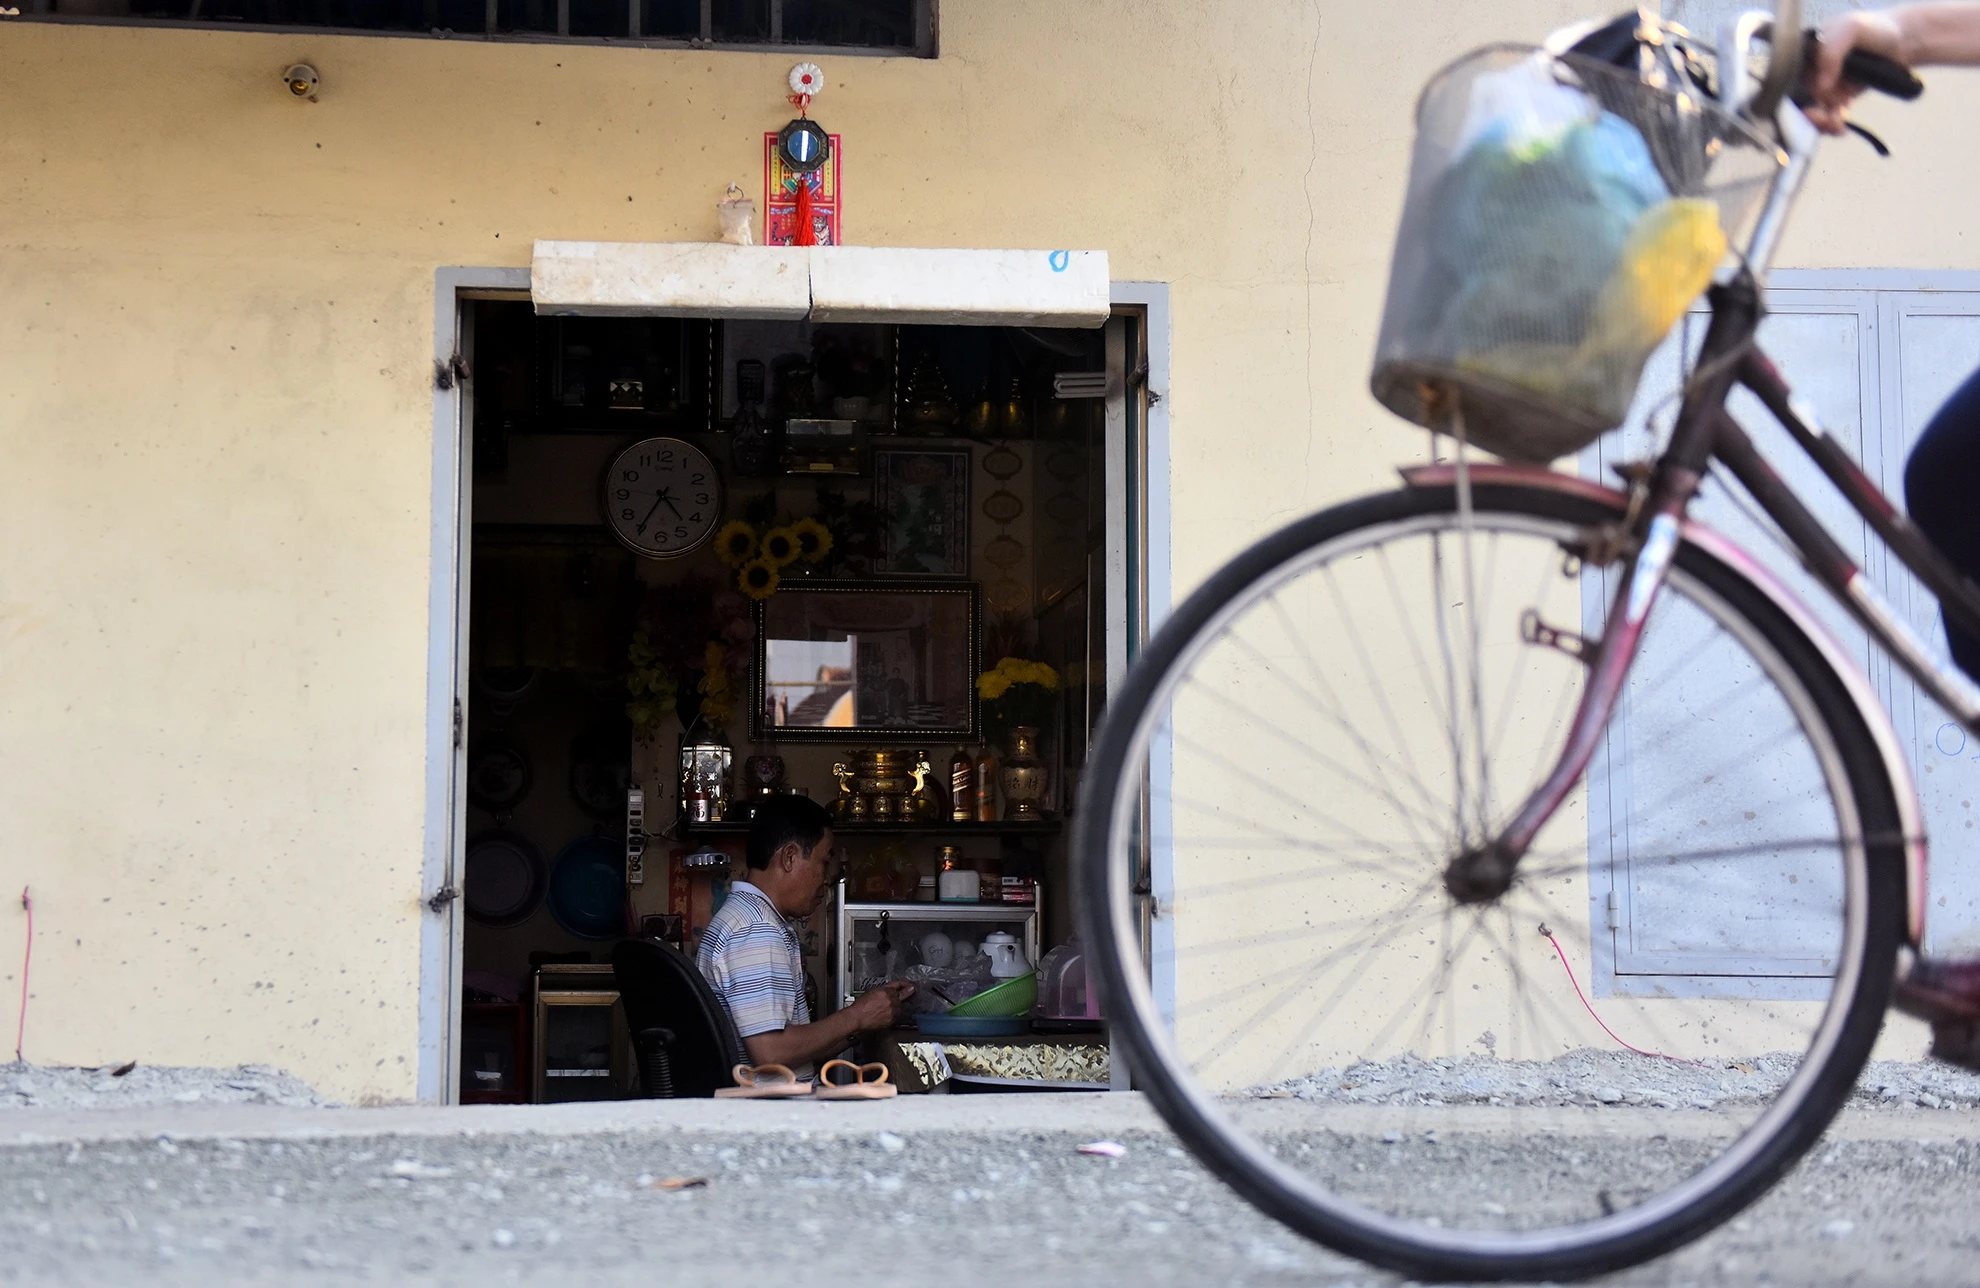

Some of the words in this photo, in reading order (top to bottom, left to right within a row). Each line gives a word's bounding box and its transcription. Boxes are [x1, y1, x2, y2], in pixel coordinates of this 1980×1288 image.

[640, 455, 651, 467] 11
[656, 450, 674, 463] 12
[682, 457, 688, 469] 1
[622, 470, 640, 483] 10
[690, 473, 705, 486] 2
[616, 488, 630, 501] 9
[695, 492, 709, 505] 3
[621, 508, 635, 521] 8
[688, 511, 702, 524] 4
[654, 531, 668, 544] 6
[674, 525, 688, 538] 5
